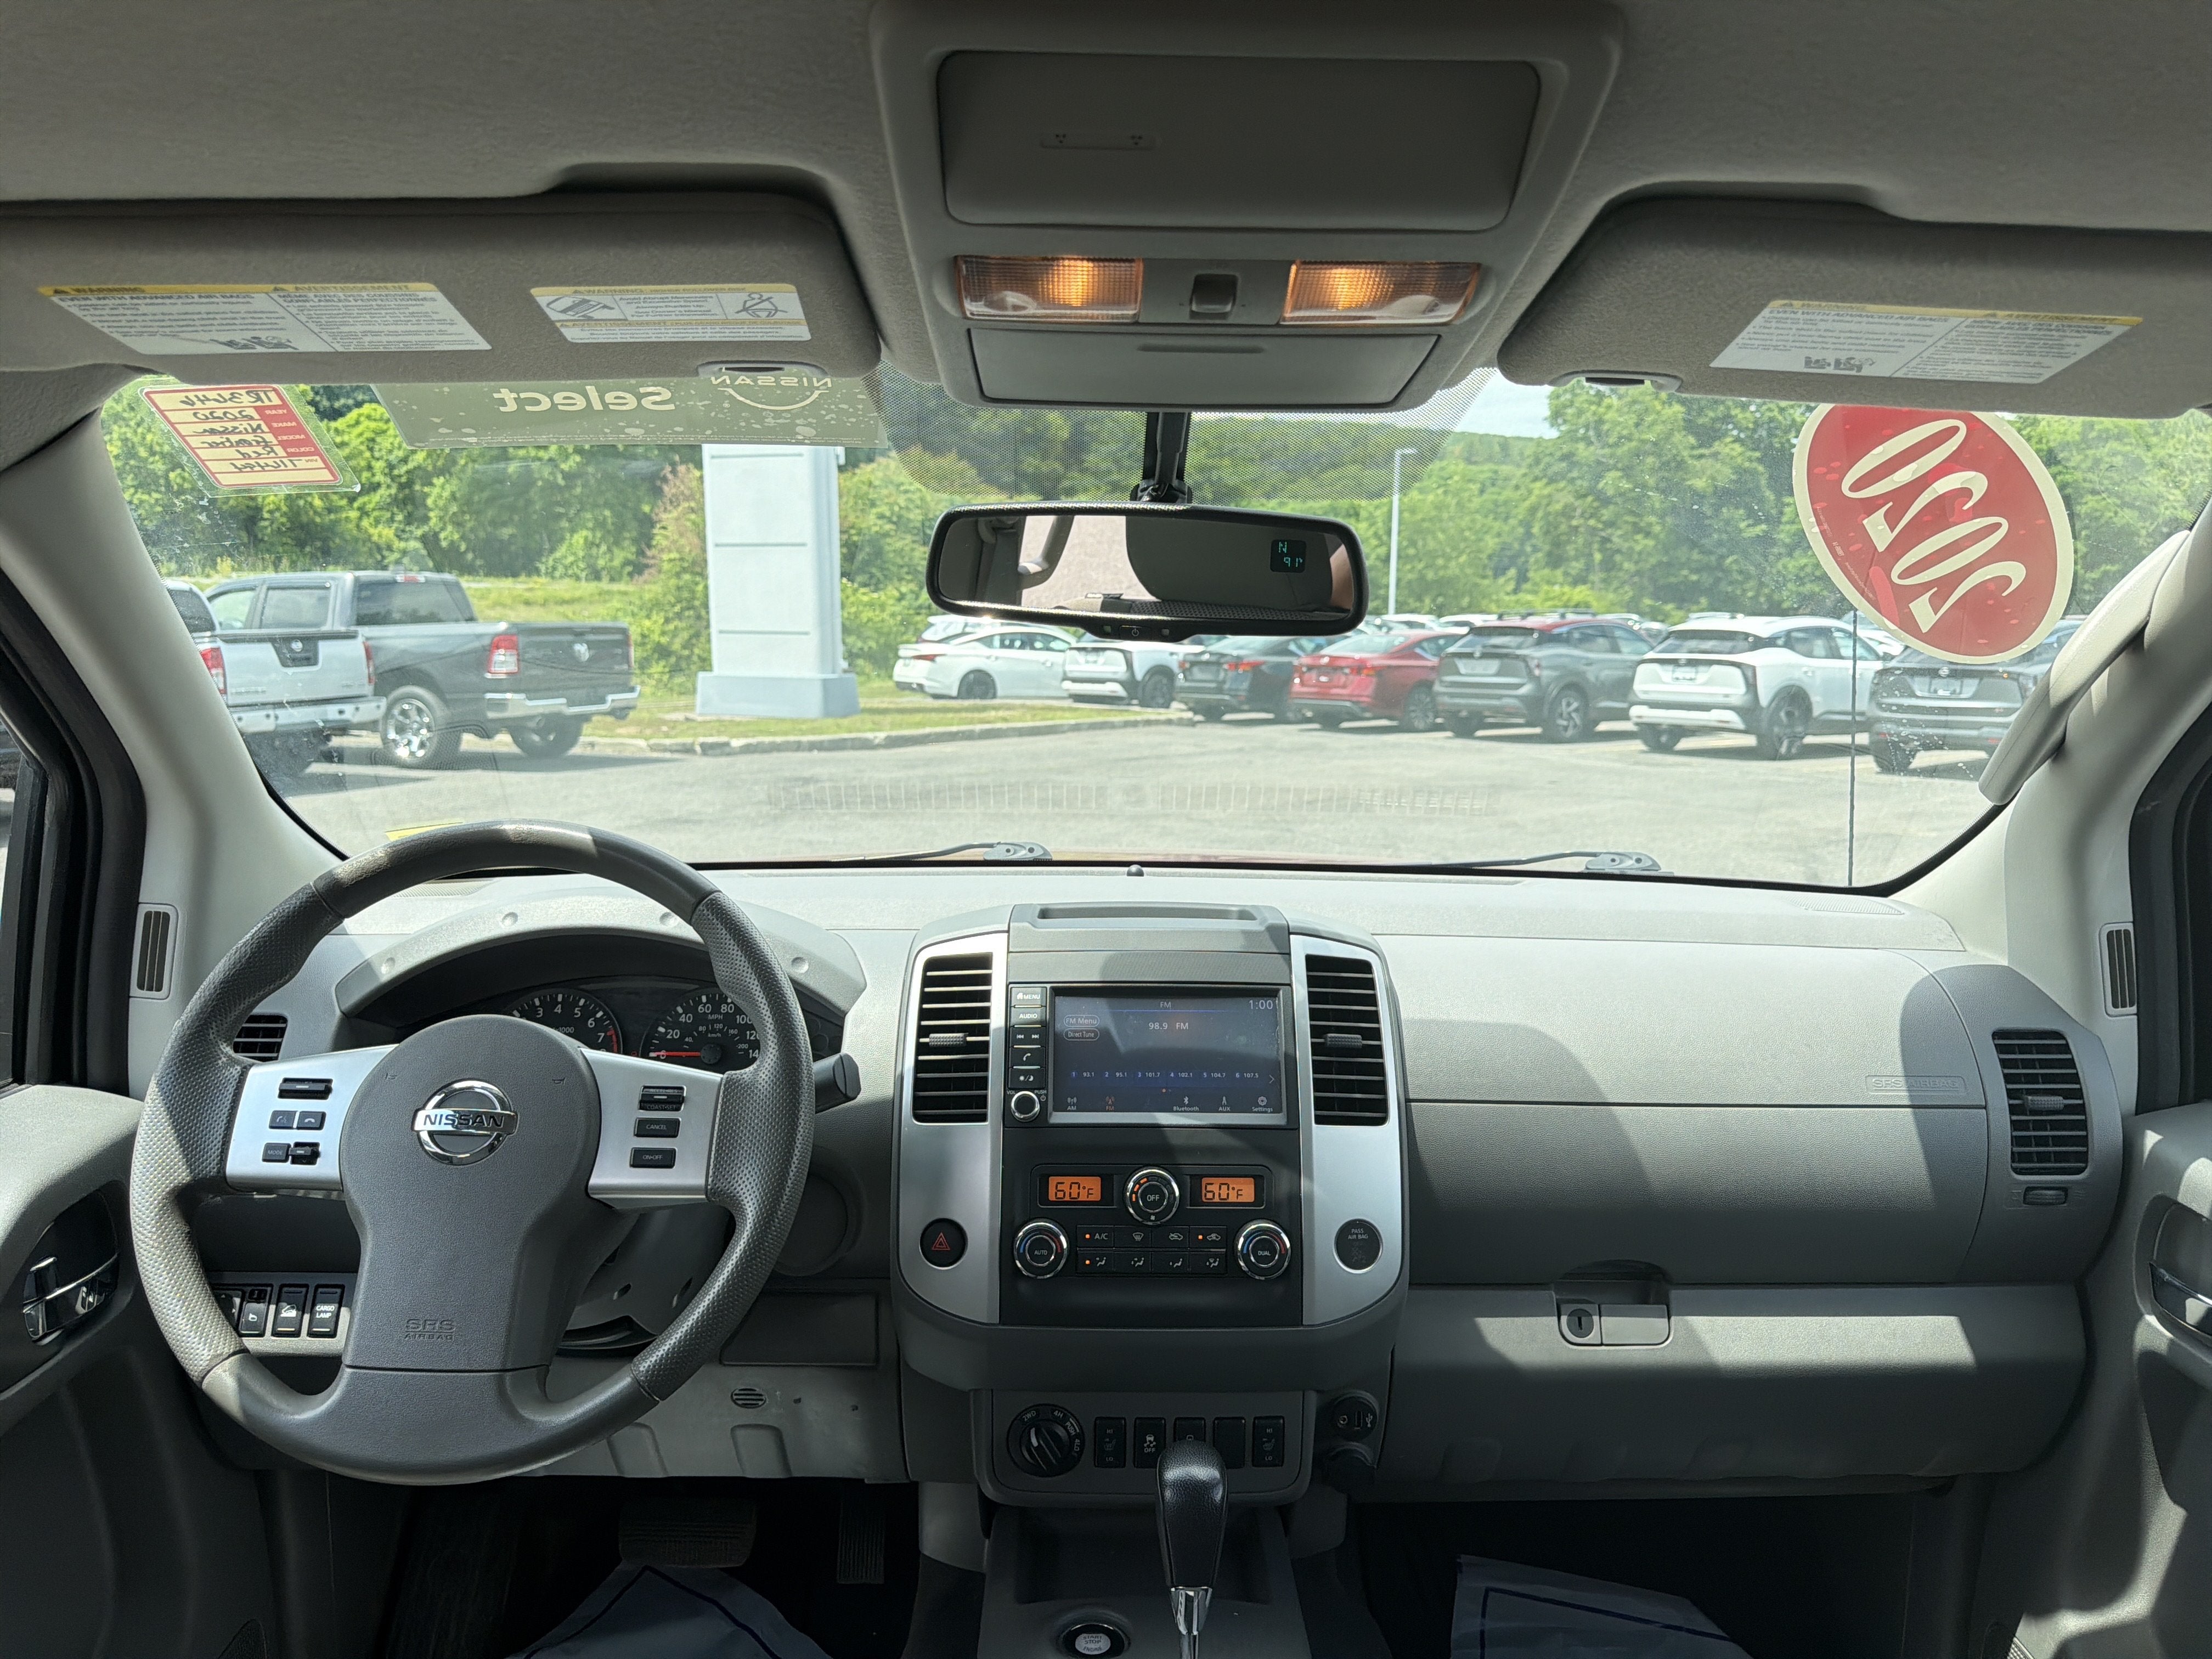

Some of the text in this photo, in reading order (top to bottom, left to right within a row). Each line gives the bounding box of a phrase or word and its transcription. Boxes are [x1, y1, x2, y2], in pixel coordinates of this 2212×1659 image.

[554, 1004, 562, 1014] 4
[698, 1004, 712, 1013] 60
[720, 1004, 735, 1013] 80
[1249, 1000, 1273, 1009] 1:00
[536, 1008, 543, 1017] 3
[574, 1008, 581, 1018] 5
[588, 1018, 595, 1028] 6
[679, 1014, 693, 1023] 40
[597, 1032, 605, 1043] 7
[666, 1029, 680, 1039] 20
[749, 1049, 759, 1058] 14
[423, 1114, 505, 1128] NISSAN
[1022, 1410, 1037, 1422] 2WD
[1053, 1410, 1064, 1419] 4H
[1064, 1421, 1076, 1436] PUSH
